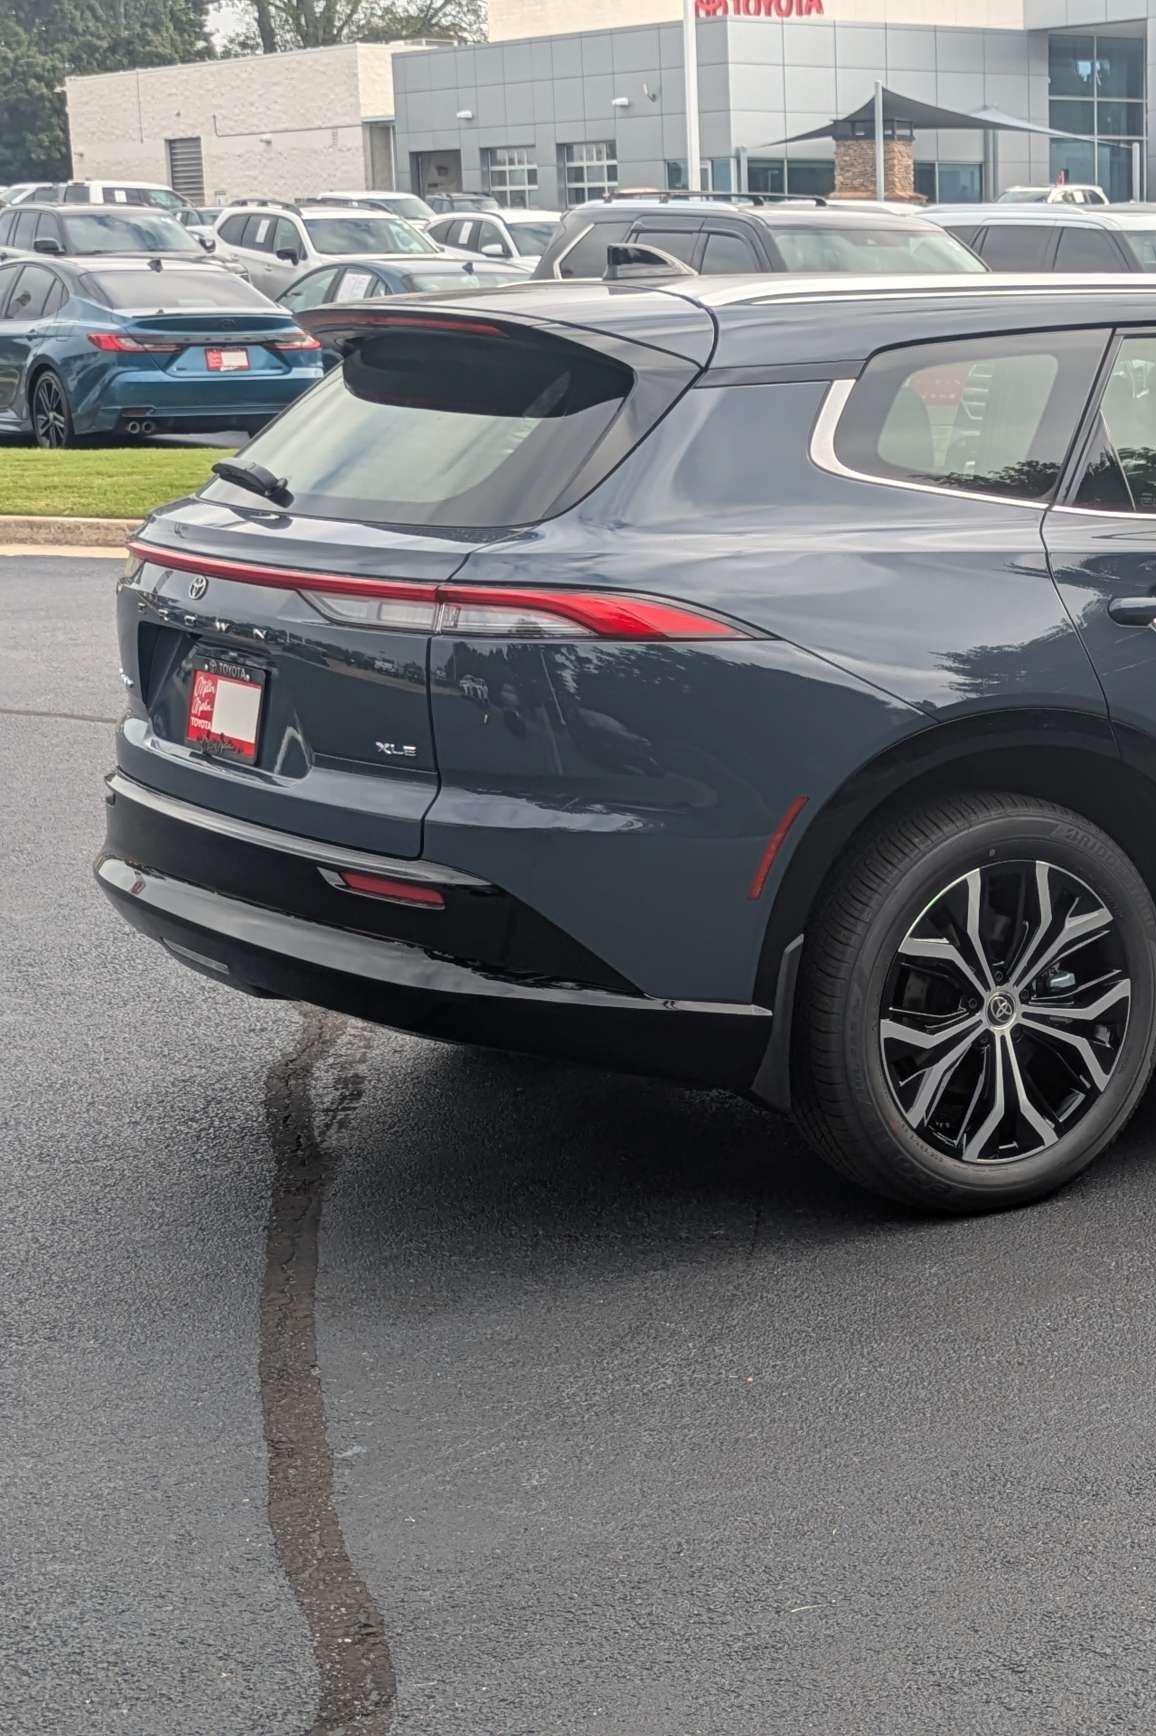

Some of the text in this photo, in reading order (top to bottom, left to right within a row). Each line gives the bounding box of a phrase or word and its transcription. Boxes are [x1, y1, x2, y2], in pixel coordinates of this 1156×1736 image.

[733, 0, 824, 17] TOYOTA
[219, 662, 247, 680] TOYOTA
[190, 716, 212, 730] TOYOTA
[375, 741, 417, 757] XLE
